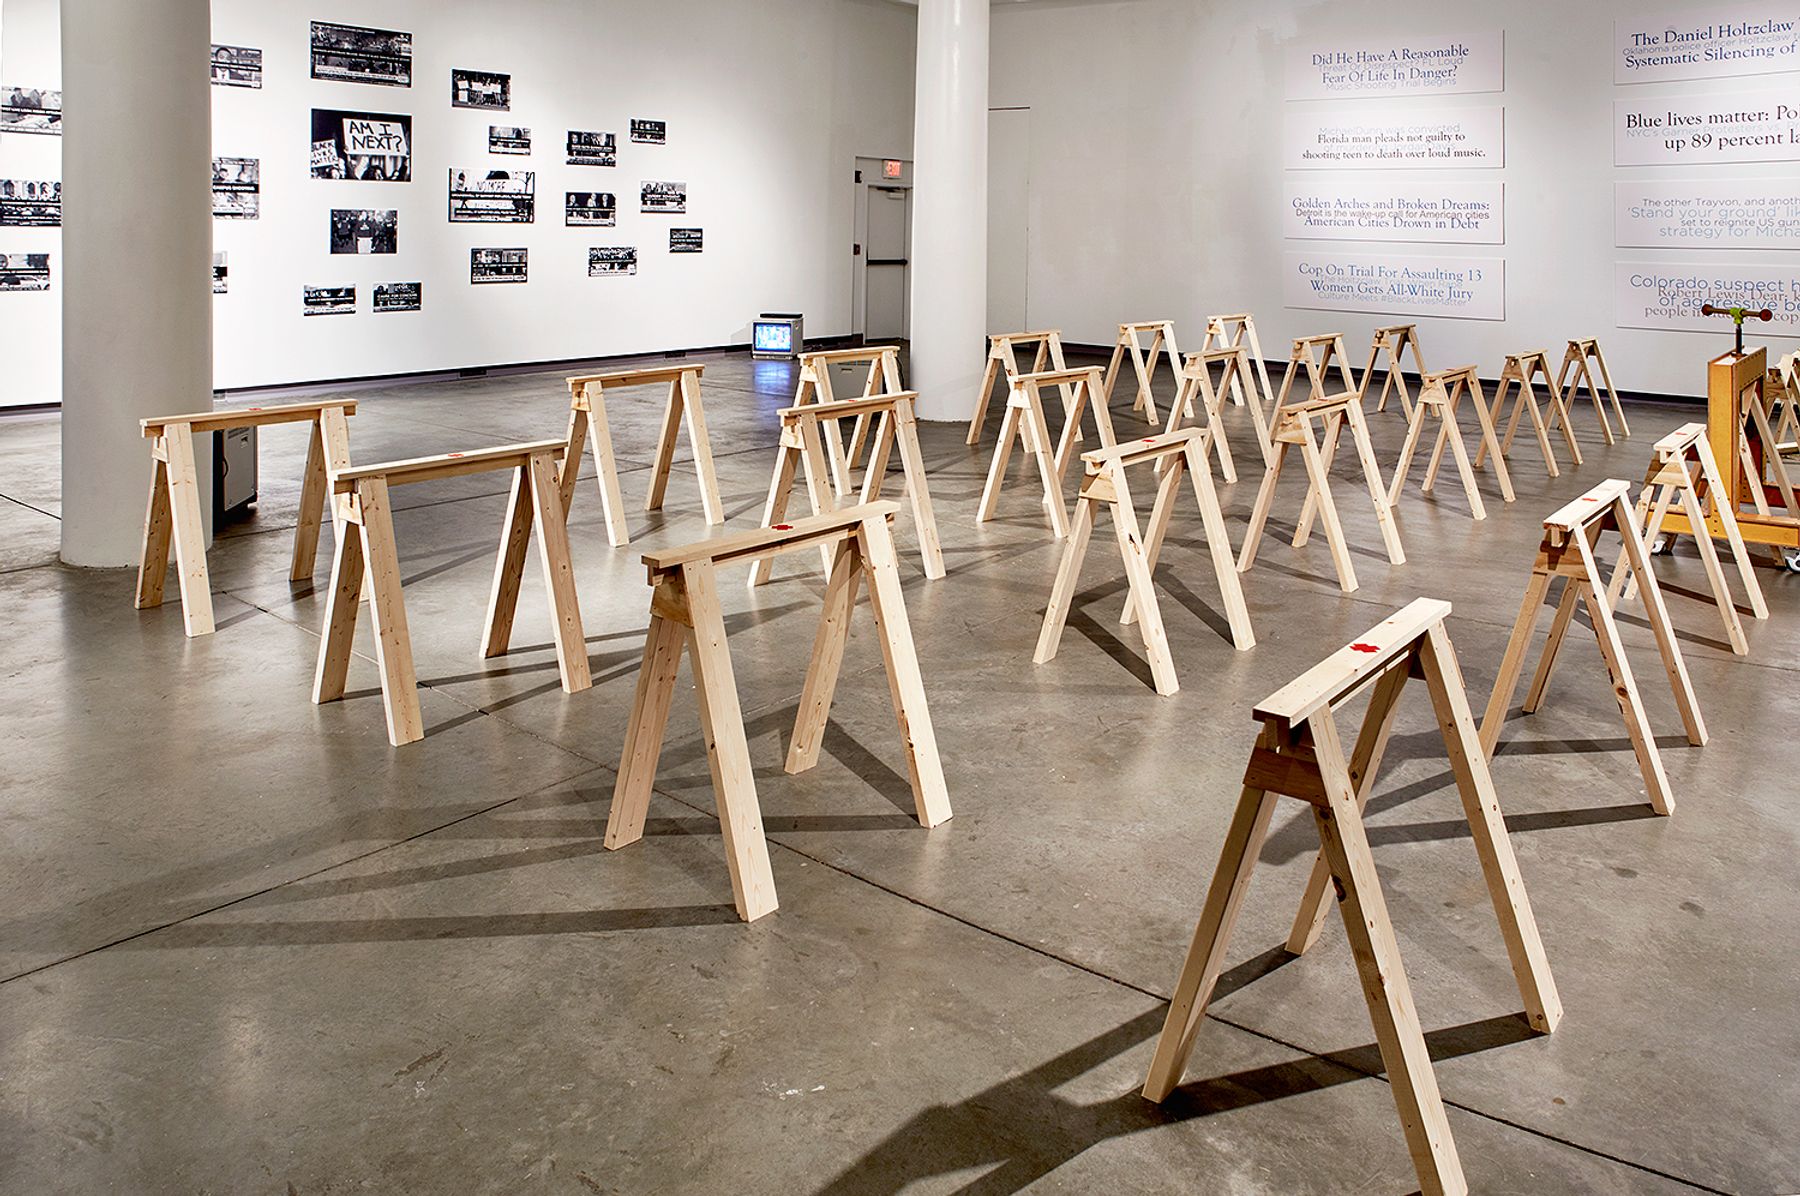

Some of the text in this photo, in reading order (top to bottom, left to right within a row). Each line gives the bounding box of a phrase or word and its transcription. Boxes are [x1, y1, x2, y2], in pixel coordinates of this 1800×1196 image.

[1631, 19, 1795, 46] The Daniel Holtzclaw
[1672, 42, 1702, 54] police
[1703, 38, 1737, 50] officer
[1312, 43, 1469, 66] Did He Have A Reasonable
[1624, 40, 1798, 70] Systematic Silencing of
[1322, 65, 1458, 84] Fear Of Life In Danger?
[1625, 104, 1800, 129] Blue lives matter: Po
[349, 119, 393, 136] AM I
[352, 134, 403, 152] NEXT?
[1316, 130, 1467, 146] Florida man pleads not guilty to
[1664, 137, 1686, 152] up
[1690, 132, 1713, 149] 89
[1718, 133, 1784, 151] percent
[1302, 146, 1487, 161] shooting teen to death over loud music.
[1291, 196, 1490, 211] Golden Arches and Broken Dreams:
[1642, 198, 1661, 207] The
[1663, 197, 1692, 207] other
[1695, 196, 1742, 208] Trayvon,
[1744, 196, 1766, 206] and
[1324, 208, 1332, 217] is
[1333, 209, 1348, 217] the
[1349, 209, 1386, 220] wake-up
[1387, 209, 1402, 218] call
[1404, 209, 1418, 219] for
[1418, 209, 1462, 221] American
[1678, 207, 1713, 221] your
[1304, 217, 1480, 230] American Cities Drown in Debt
[1680, 217, 1697, 227] set
[1699, 218, 1712, 227] to
[1713, 217, 1756, 229] reignite
[1758, 217, 1775, 227] US
[1659, 226, 1723, 240] strategy
[1727, 225, 1751, 238] for
[1298, 262, 1483, 283] Cop On Trial For Assaulting 13
[1310, 279, 1474, 302] Women Gets All-White Jury
[1630, 274, 1709, 289] Colorado
[1714, 278, 1785, 293] suspect
[1658, 285, 1702, 299] Robert
[1707, 286, 1745, 300] Lewis
[1659, 295, 1677, 308] of
[1682, 296, 1778, 312] aggressive
[1644, 305, 1688, 319] people
